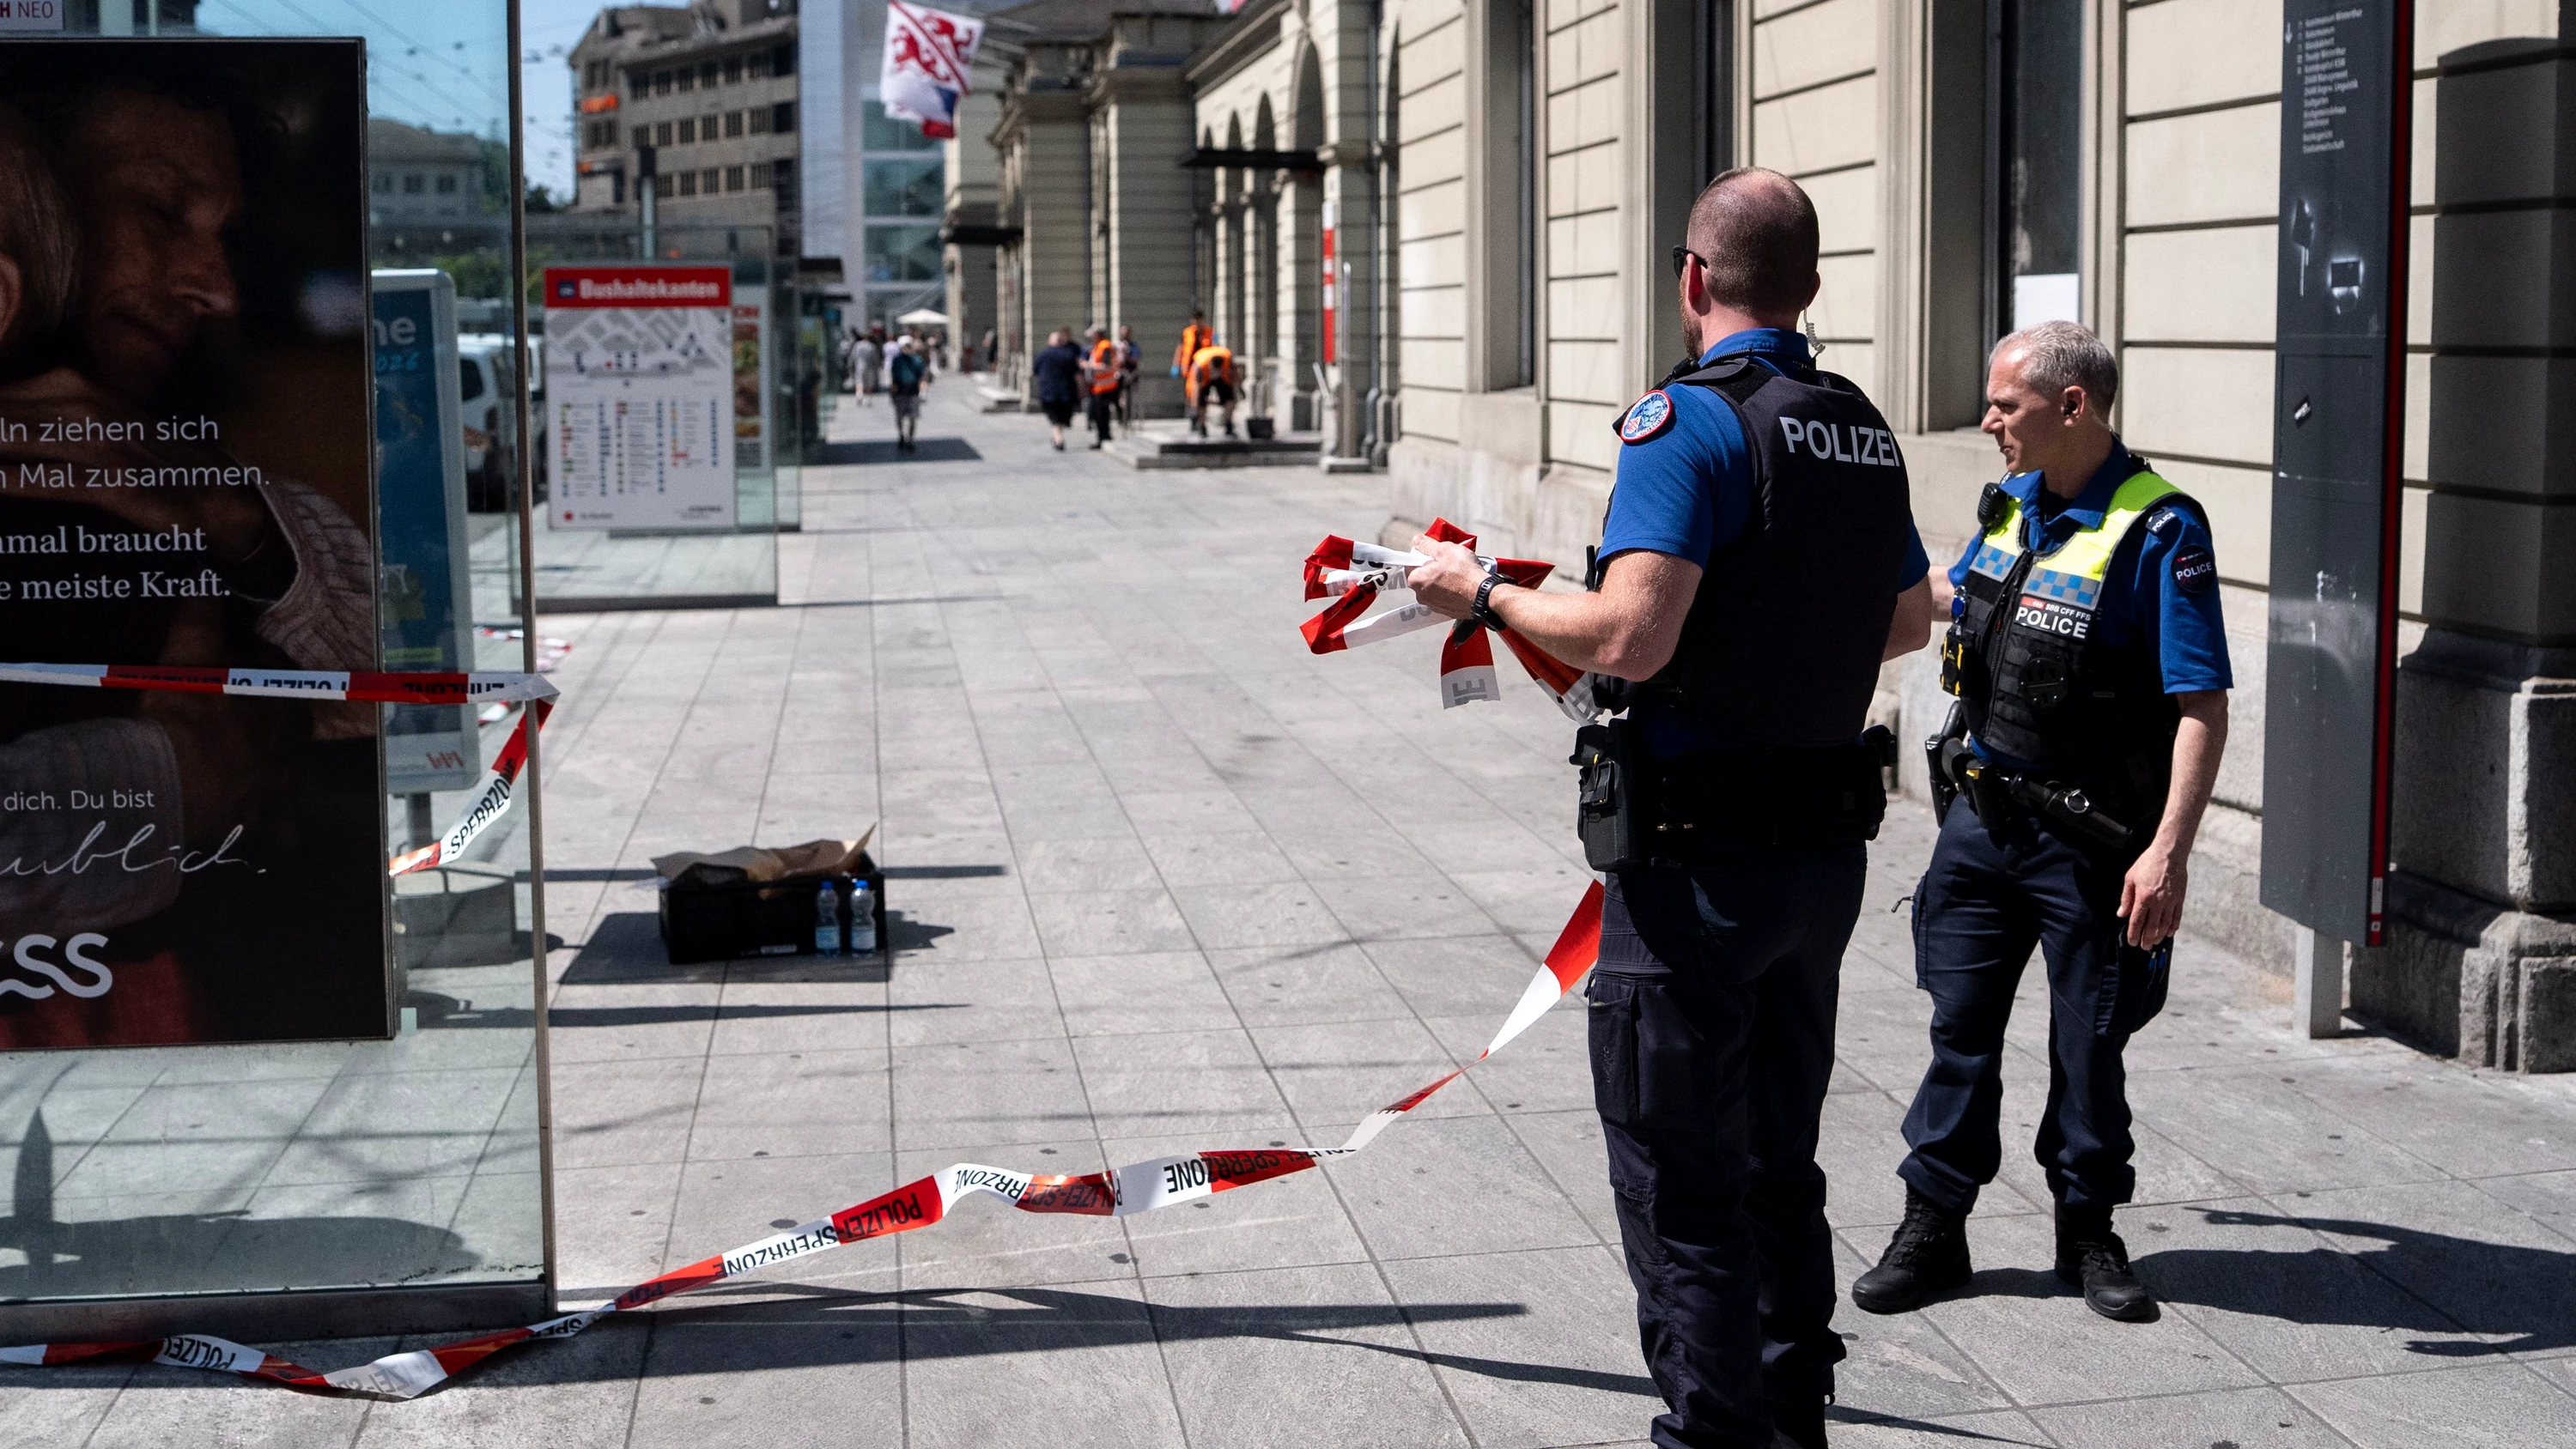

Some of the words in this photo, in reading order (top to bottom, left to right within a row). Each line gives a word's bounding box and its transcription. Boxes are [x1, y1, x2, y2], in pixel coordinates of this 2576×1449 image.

[18, 1, 53, 18] NEO
[579, 277, 720, 299] Bushaltekanten
[39, 416, 145, 442] ziehen
[156, 415, 219, 440] sich
[1778, 416, 1901, 467] POLIZEI
[20, 462, 75, 489] Mal
[85, 465, 270, 488] zusammen.
[2152, 512, 2176, 532] POLICE
[76, 524, 208, 554] braucht
[21, 573, 131, 600] meiste
[139, 568, 232, 598] Kraft.
[2175, 561, 2213, 580] POLICE
[2015, 606, 2089, 640] POLICE
[2045, 603, 2060, 613] SBB
[2061, 607, 2075, 616] CFF
[2075, 611, 2092, 621] FFS
[3, 791, 61, 811] dich.
[70, 790, 104, 809] Du
[112, 789, 155, 809] bist
[713, 1192, 923, 1276] POLIZEI-SPERRZONE
